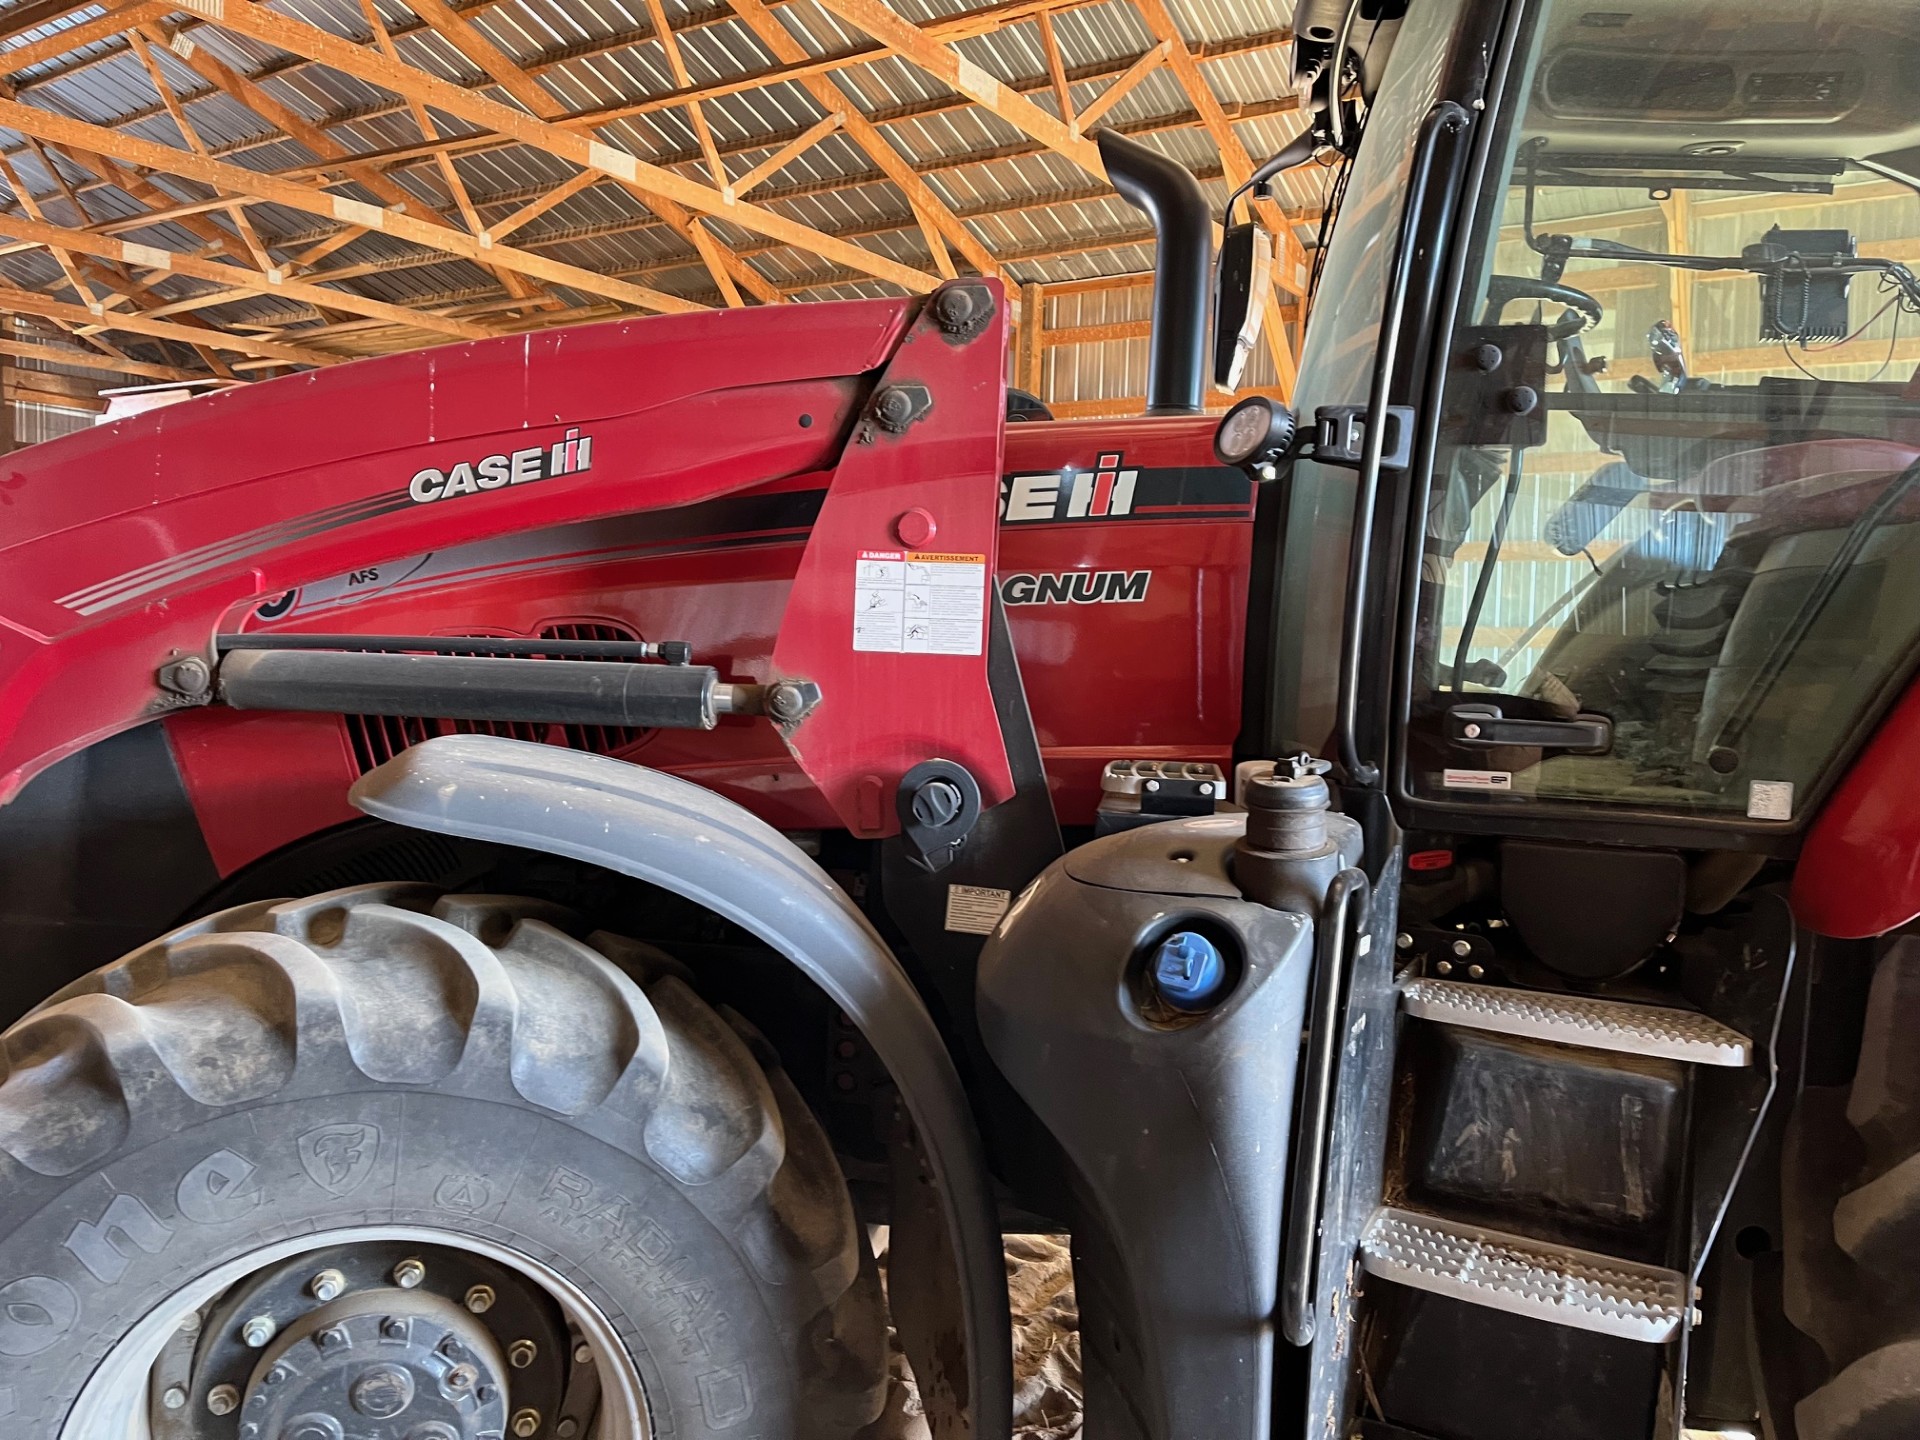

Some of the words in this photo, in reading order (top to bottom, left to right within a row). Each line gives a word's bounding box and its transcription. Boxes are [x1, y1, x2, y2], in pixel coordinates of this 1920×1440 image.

[409, 447, 543, 503] CASE
[921, 554, 979, 562] AVERTISSEMENT
[349, 568, 379, 586] AFS
[538, 1164, 731, 1357] RADIAL
